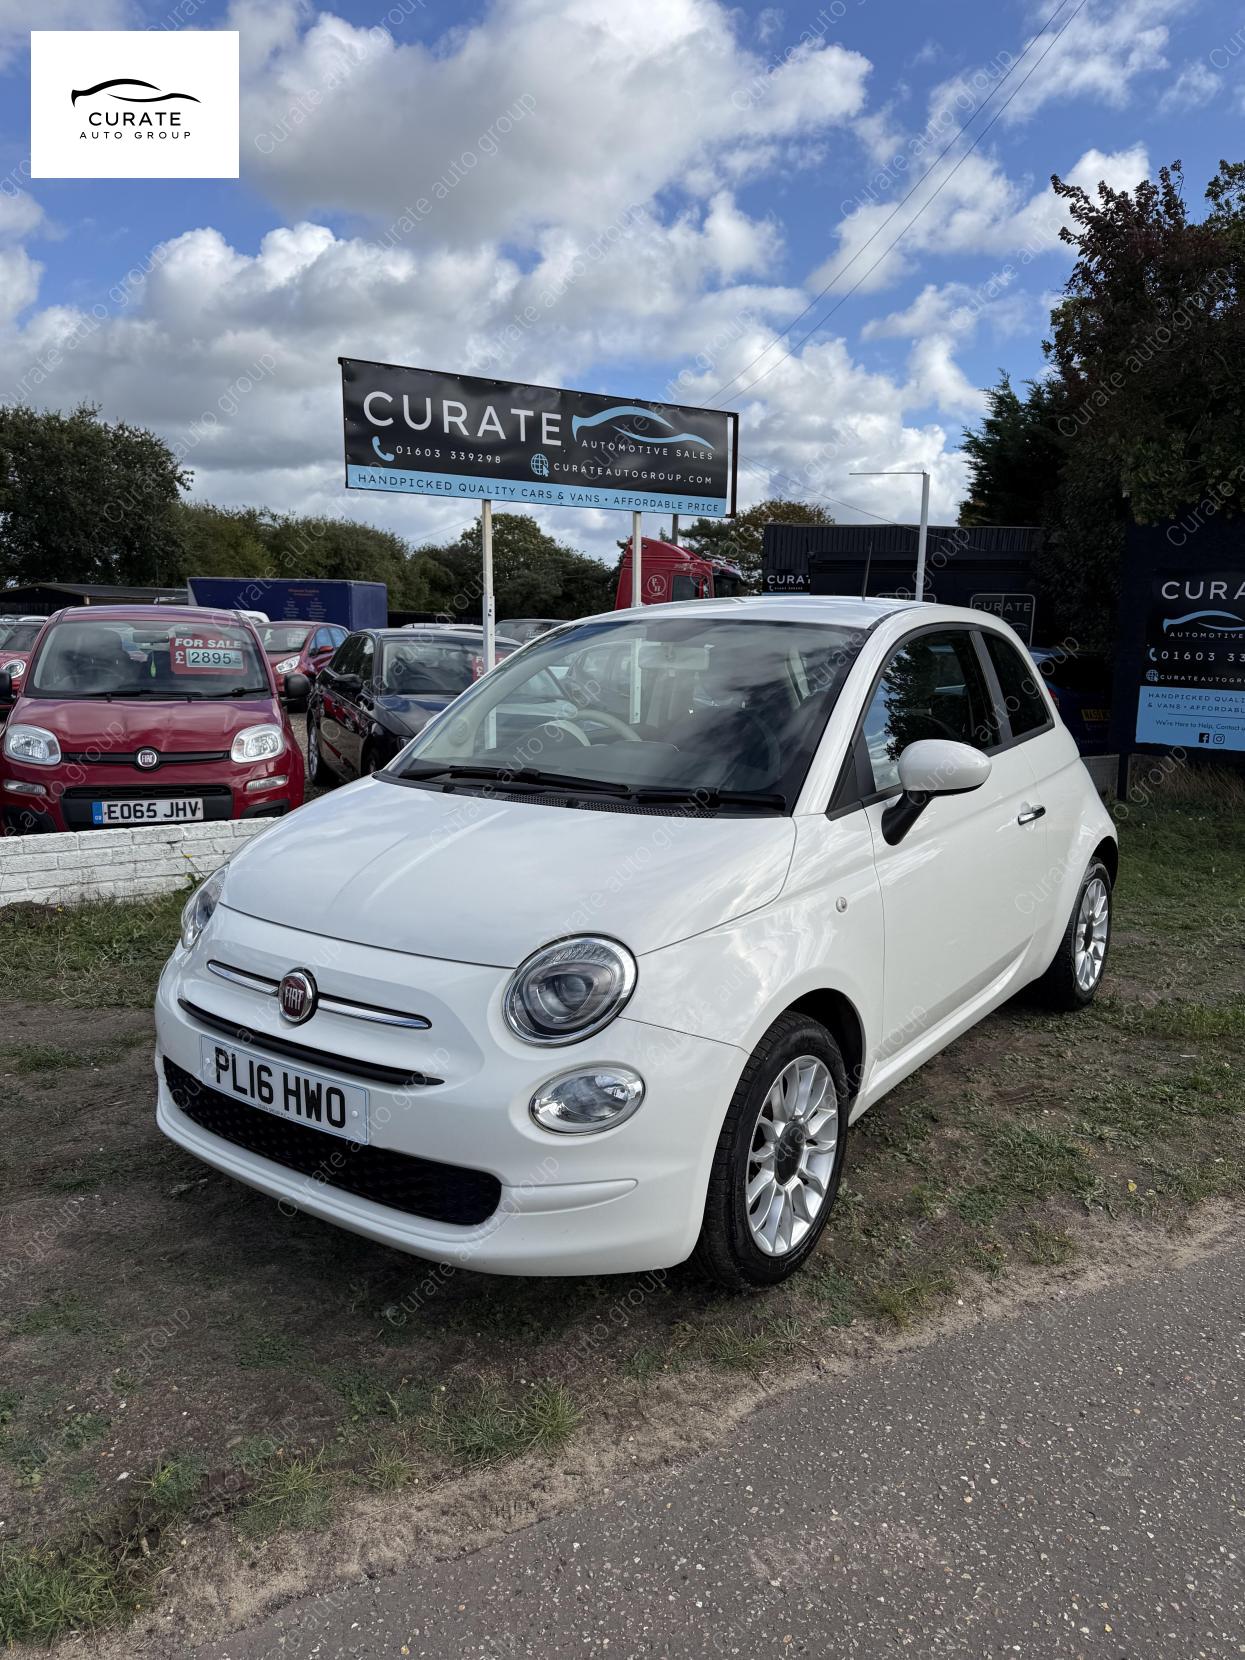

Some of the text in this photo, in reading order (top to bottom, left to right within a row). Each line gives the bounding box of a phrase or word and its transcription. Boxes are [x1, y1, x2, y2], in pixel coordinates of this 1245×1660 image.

[363, 390, 562, 446] CURATE
[396, 445, 502, 464] 01603 339298
[581, 440, 714, 460] AUTOMOTIVE SALES
[553, 463, 713, 484] CURATEAUTOGROUP.COM
[358, 473, 719, 512] HANDPICKED QUALITY CARS & VANS AFFORDABLE PRICE
[175, 638, 241, 649] FOR SALE
[1170, 631, 1244, 639] AUTOMOTIVE
[175, 650, 185, 664] £
[191, 652, 231, 665] 2895
[1161, 651, 1216, 661] 01603
[1160, 674, 1245, 683] CURATEAUTOGR
[1148, 693, 1211, 702] HANDPICKED
[164, 801, 199, 818] JHV
[285, 986, 305, 1011] FIAT
[214, 1046, 346, 1129] PL16 HWO
